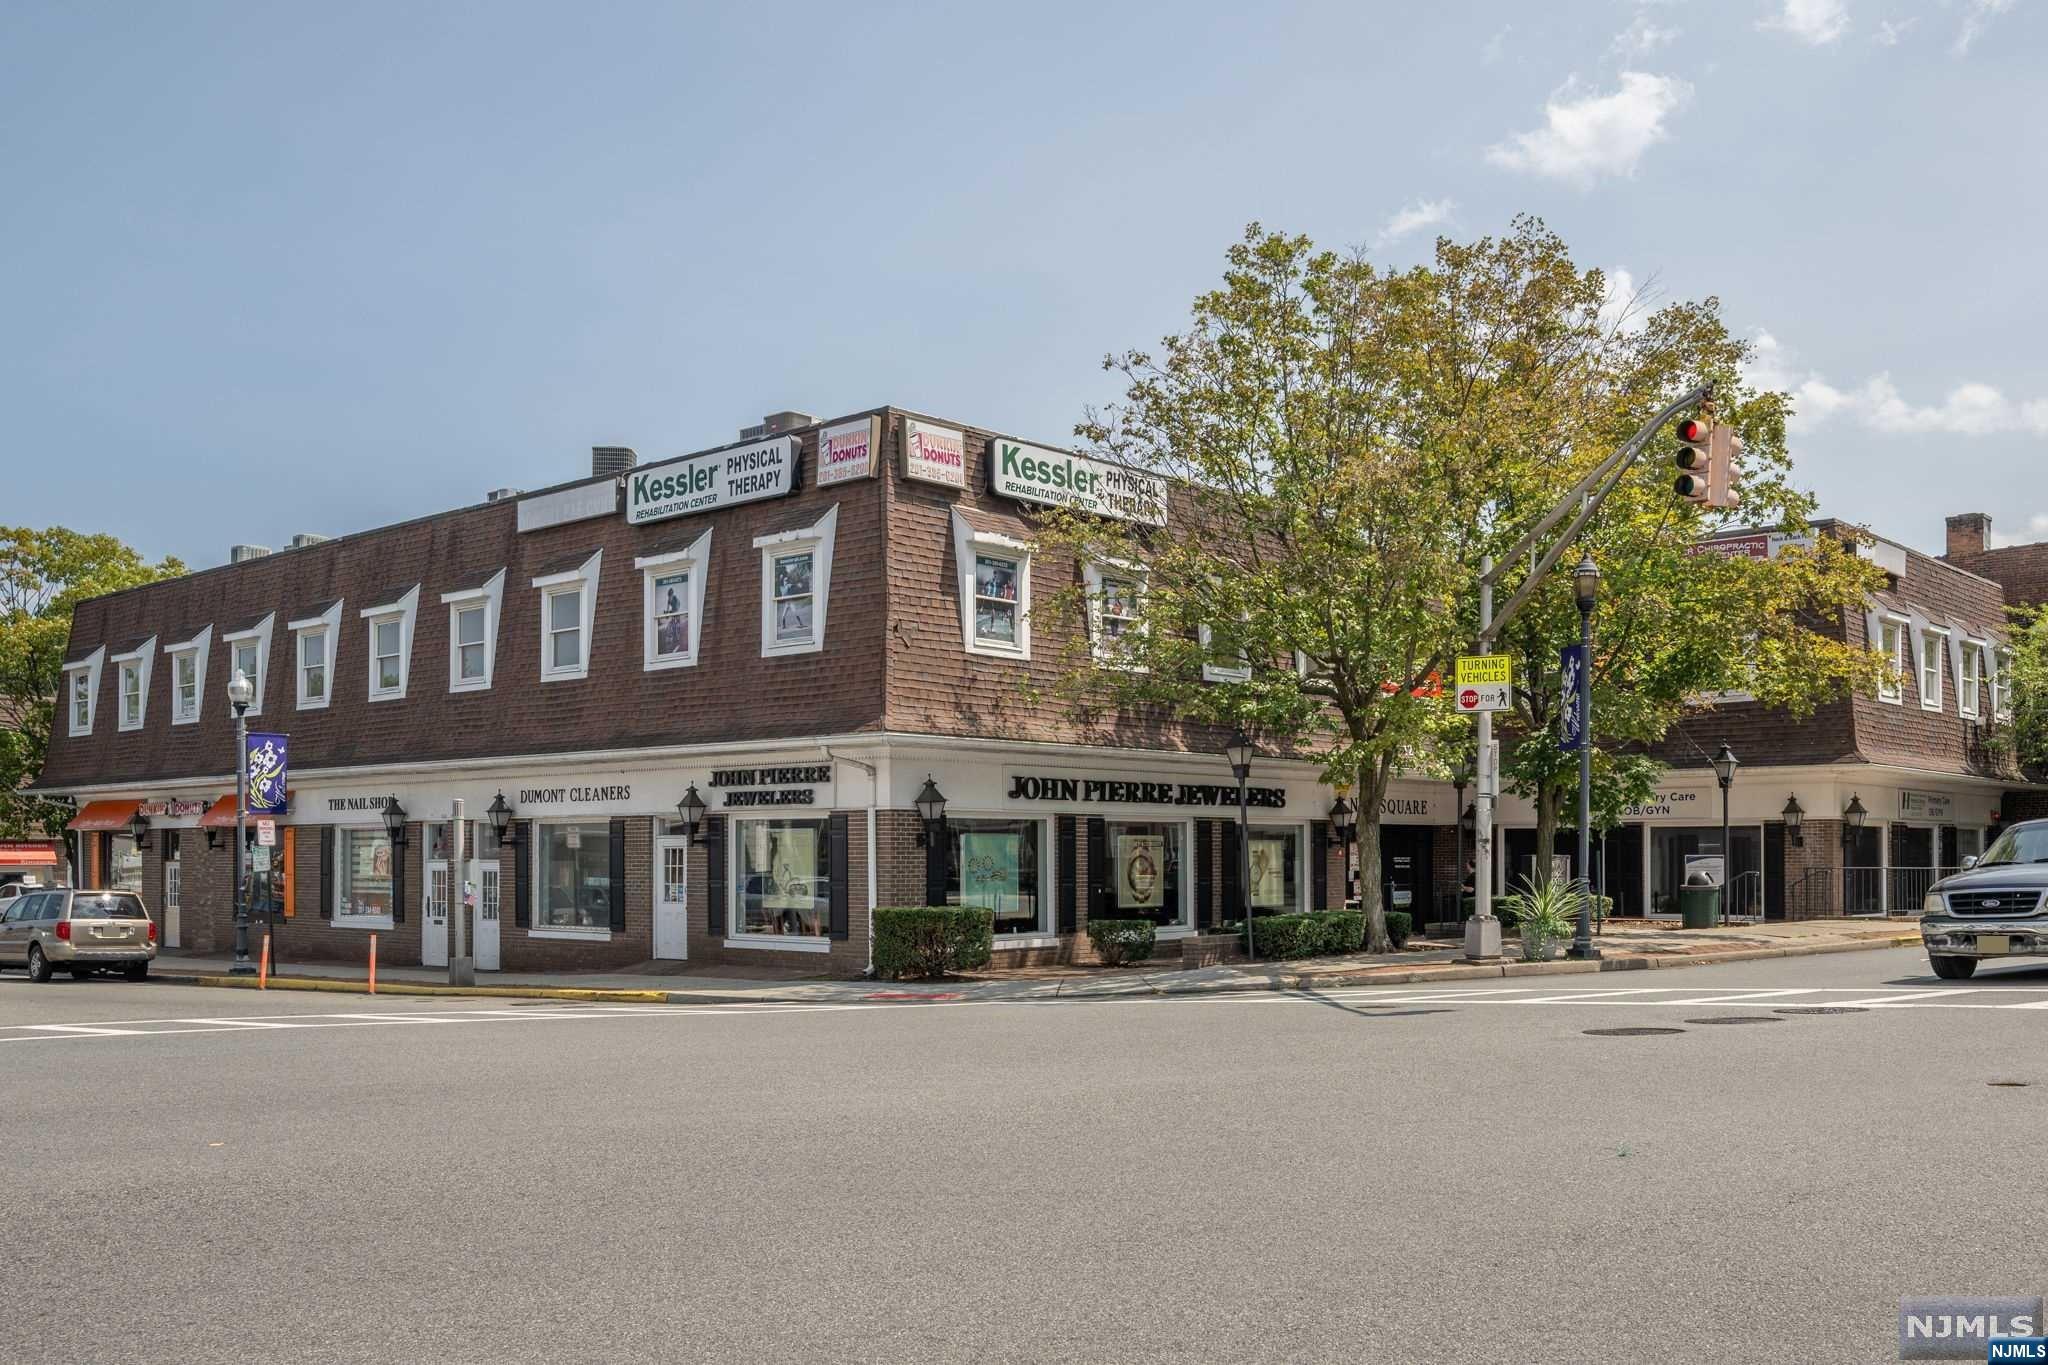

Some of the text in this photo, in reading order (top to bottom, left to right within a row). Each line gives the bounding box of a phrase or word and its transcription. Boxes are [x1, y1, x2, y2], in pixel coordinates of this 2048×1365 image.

[727, 447, 782, 475] PHYSICAL
[833, 445, 867, 463] DONUTS
[924, 448, 961, 467] DONUTS
[1002, 444, 1098, 494] Kessler
[633, 464, 718, 505] Kessler
[727, 469, 781, 497] THERAPY
[1106, 471, 1159, 497] PHYSICAL
[1005, 481, 1098, 509] REHABILITATION CENTER
[636, 493, 718, 520] REHABILITATION CENTER
[1697, 542, 1765, 553] CHIROPRACTIC
[1462, 659, 1505, 671] TURNING
[1460, 671, 1506, 683] VEHICLES
[1461, 694, 1495, 703] STOP FOR
[708, 765, 831, 787] JOHN PIERRE
[520, 785, 631, 804] DUMONT CLEANERS
[723, 789, 814, 807] JEWELERS
[1008, 775, 1080, 801] JOHN
[1081, 779, 1174, 805] PIERRE
[1670, 792, 1696, 801] Care
[328, 799, 346, 811] THE
[348, 798, 368, 810] NAIL
[1380, 799, 1428, 815] SQUARE
[1624, 806, 1670, 816] OB/GYN
